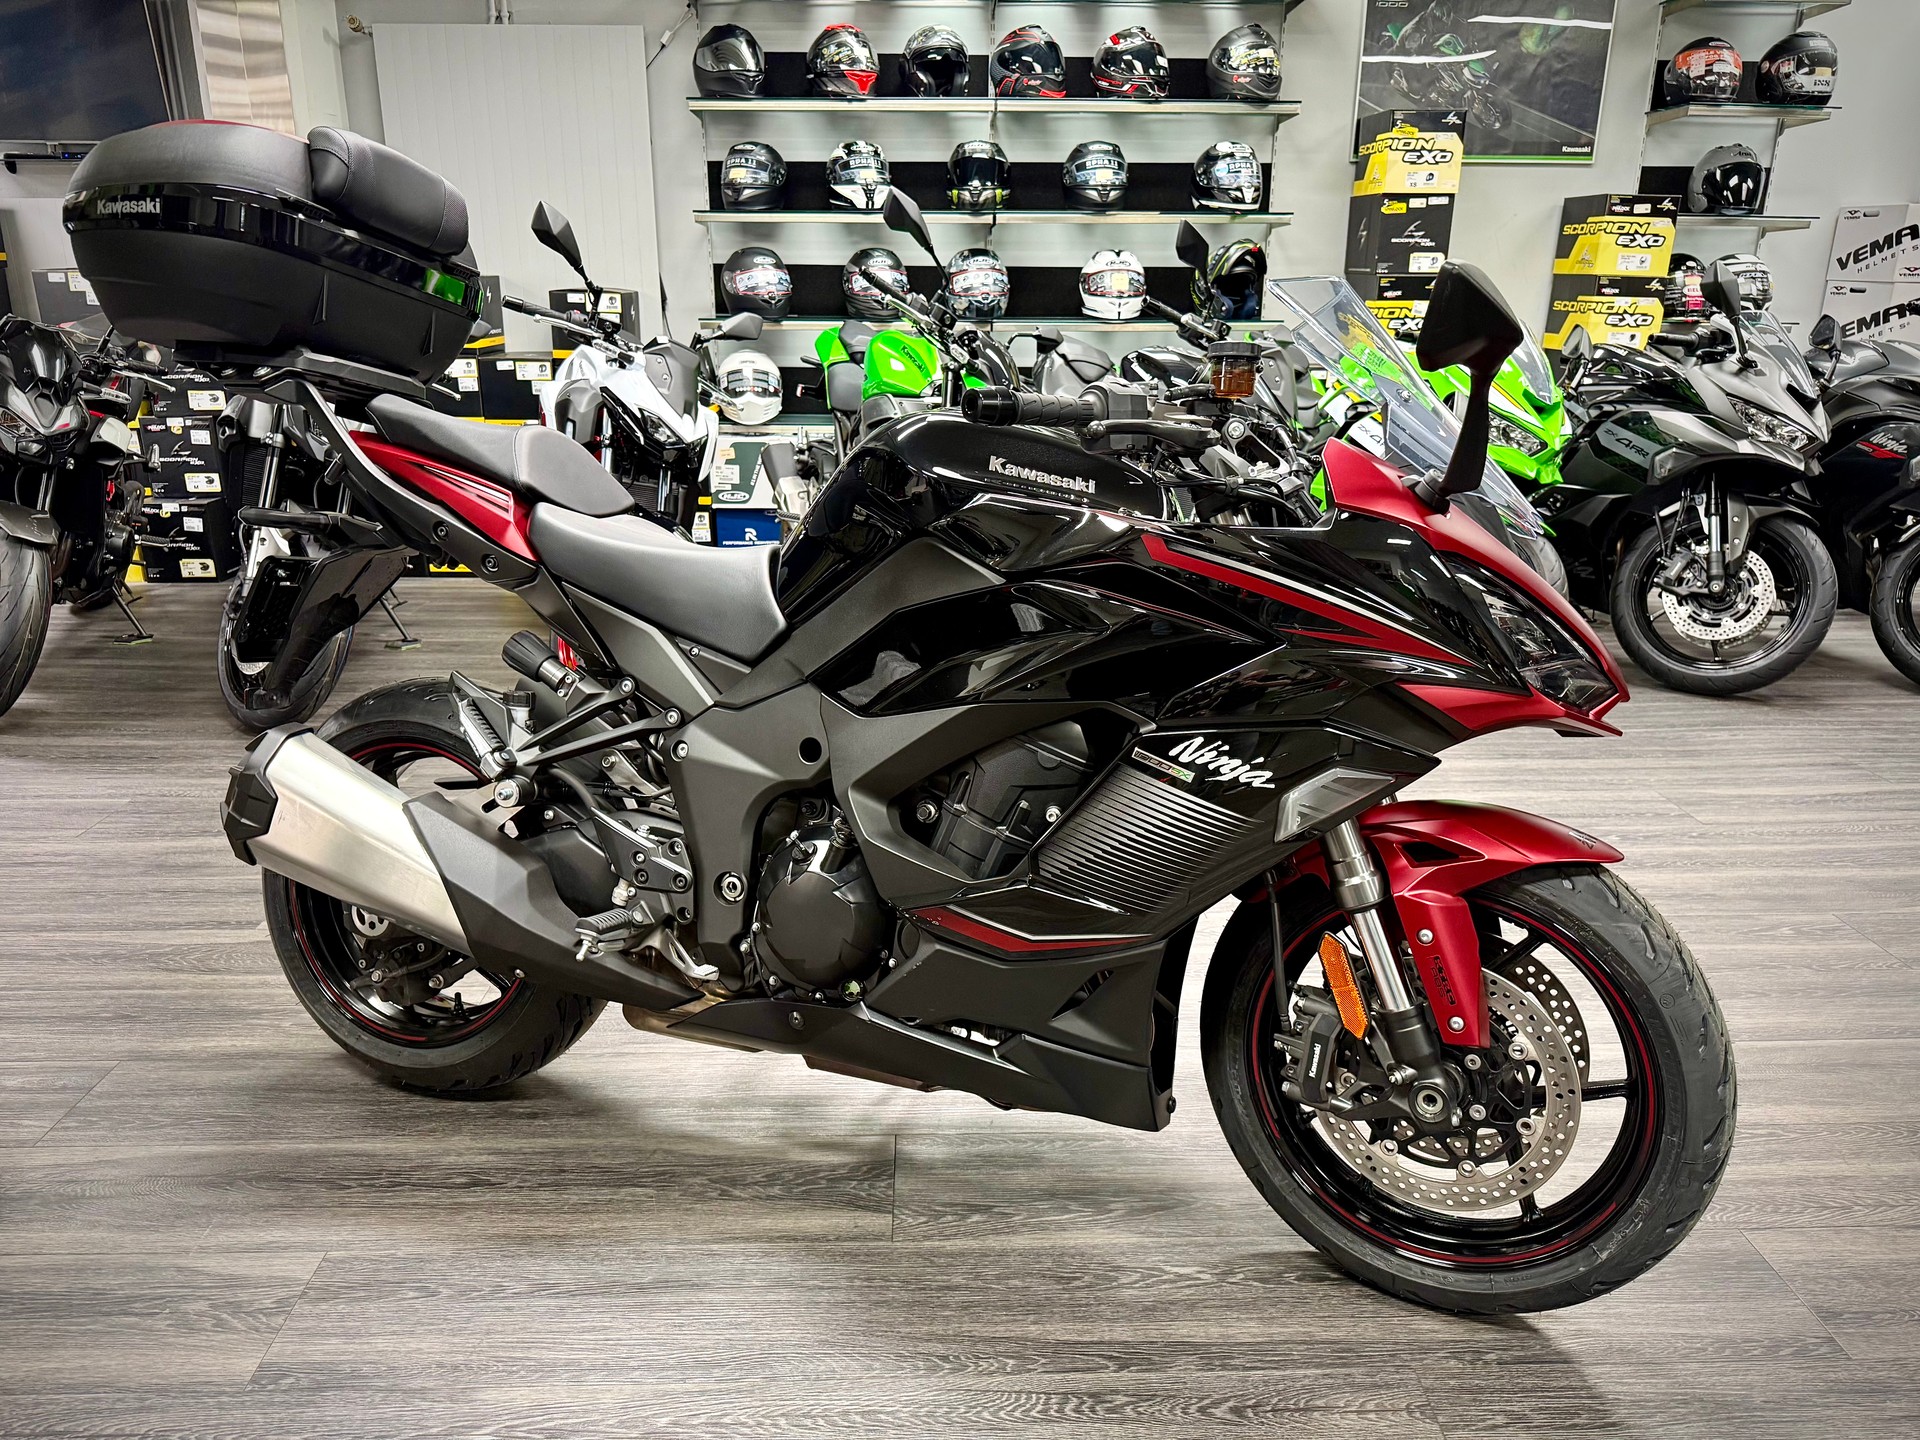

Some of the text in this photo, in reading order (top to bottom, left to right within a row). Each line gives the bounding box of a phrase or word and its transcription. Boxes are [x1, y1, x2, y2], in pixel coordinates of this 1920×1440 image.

[1359, 137, 1436, 156] SCORPION
[1561, 145, 1591, 153] Kawasaki
[1085, 159, 1109, 167] RPHA
[1229, 162, 1251, 170] RPHA
[97, 198, 161, 214] Kawasaki
[1562, 222, 1649, 236] SCORPION
[1371, 306, 1417, 320] PION
[1552, 300, 1639, 315] SCORPION
[1388, 317, 1425, 332] EX
[1841, 298, 1920, 339] EMA
[901, 344, 926, 373] Kawasaki
[1356, 423, 1385, 446] ZX-4
[1869, 432, 1908, 454] Ninja
[988, 455, 1096, 494] Kawasaki
[1168, 736, 1276, 789] Ninja
[1308, 1042, 1321, 1078] Kawasaki
